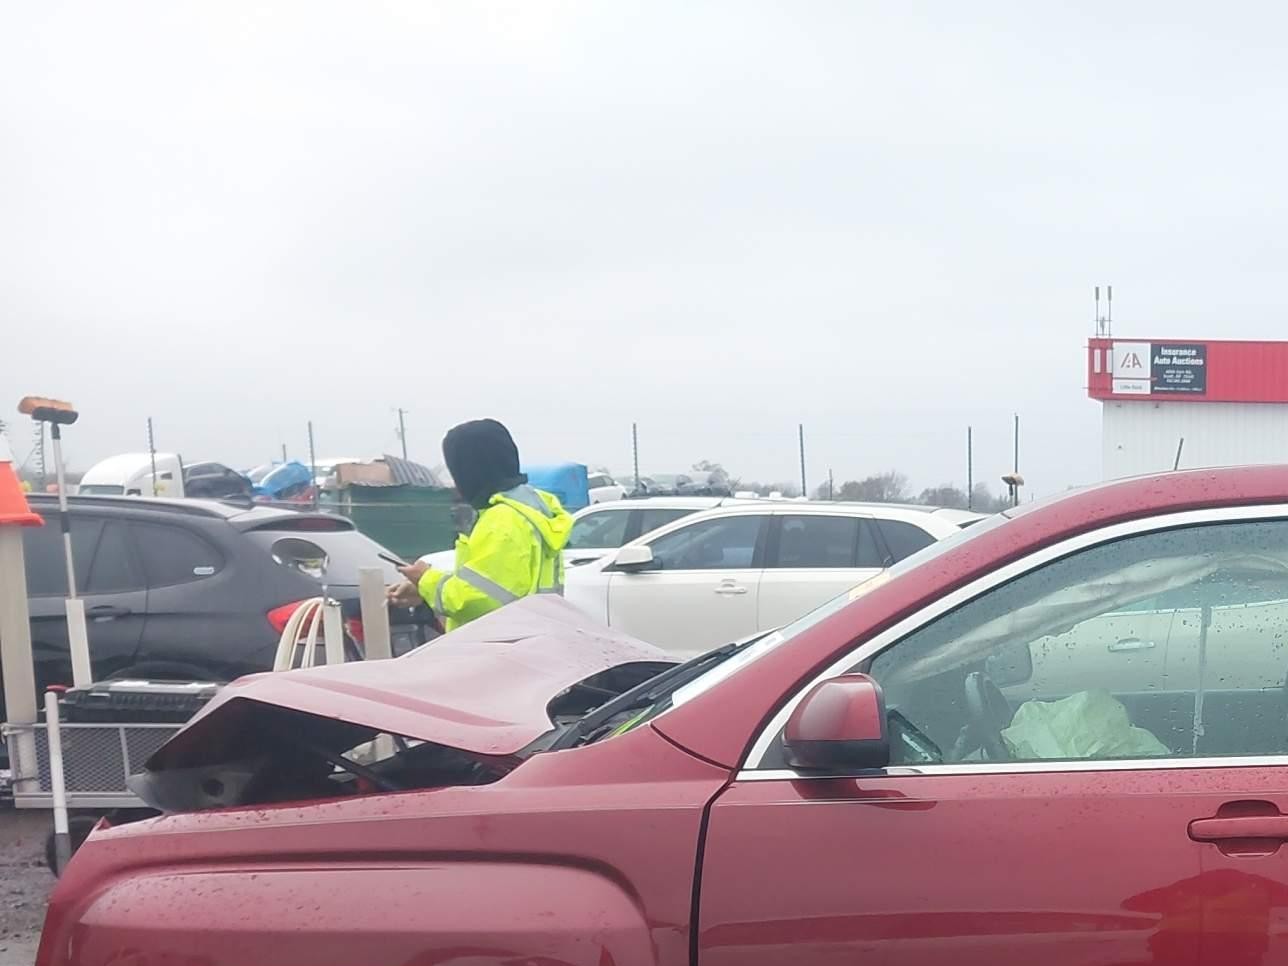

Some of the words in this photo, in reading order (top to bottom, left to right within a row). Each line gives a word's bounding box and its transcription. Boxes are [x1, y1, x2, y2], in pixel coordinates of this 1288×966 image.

[1161, 346, 1197, 356] Insurance
[1153, 355, 1171, 365] Auto
[1172, 355, 1204, 366] Auctions
